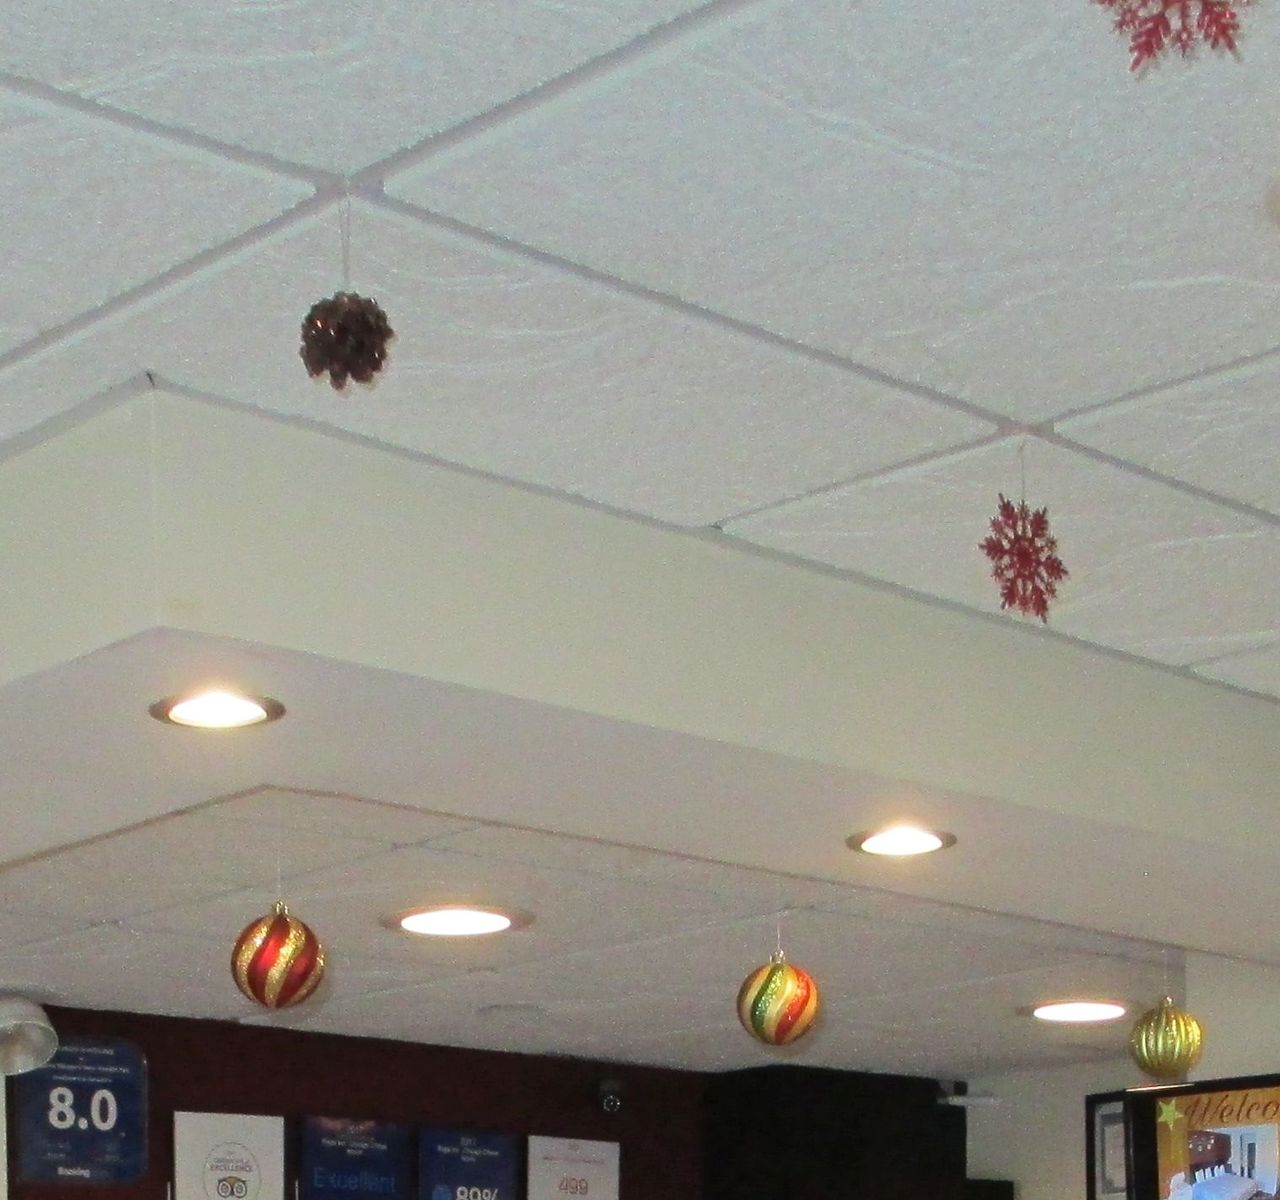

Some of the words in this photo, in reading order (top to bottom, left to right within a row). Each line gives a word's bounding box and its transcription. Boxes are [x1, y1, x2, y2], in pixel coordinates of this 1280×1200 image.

[48, 1086, 118, 1131] 8.0
[314, 1166, 396, 1193] Excellent
[559, 1176, 588, 1195] 499
